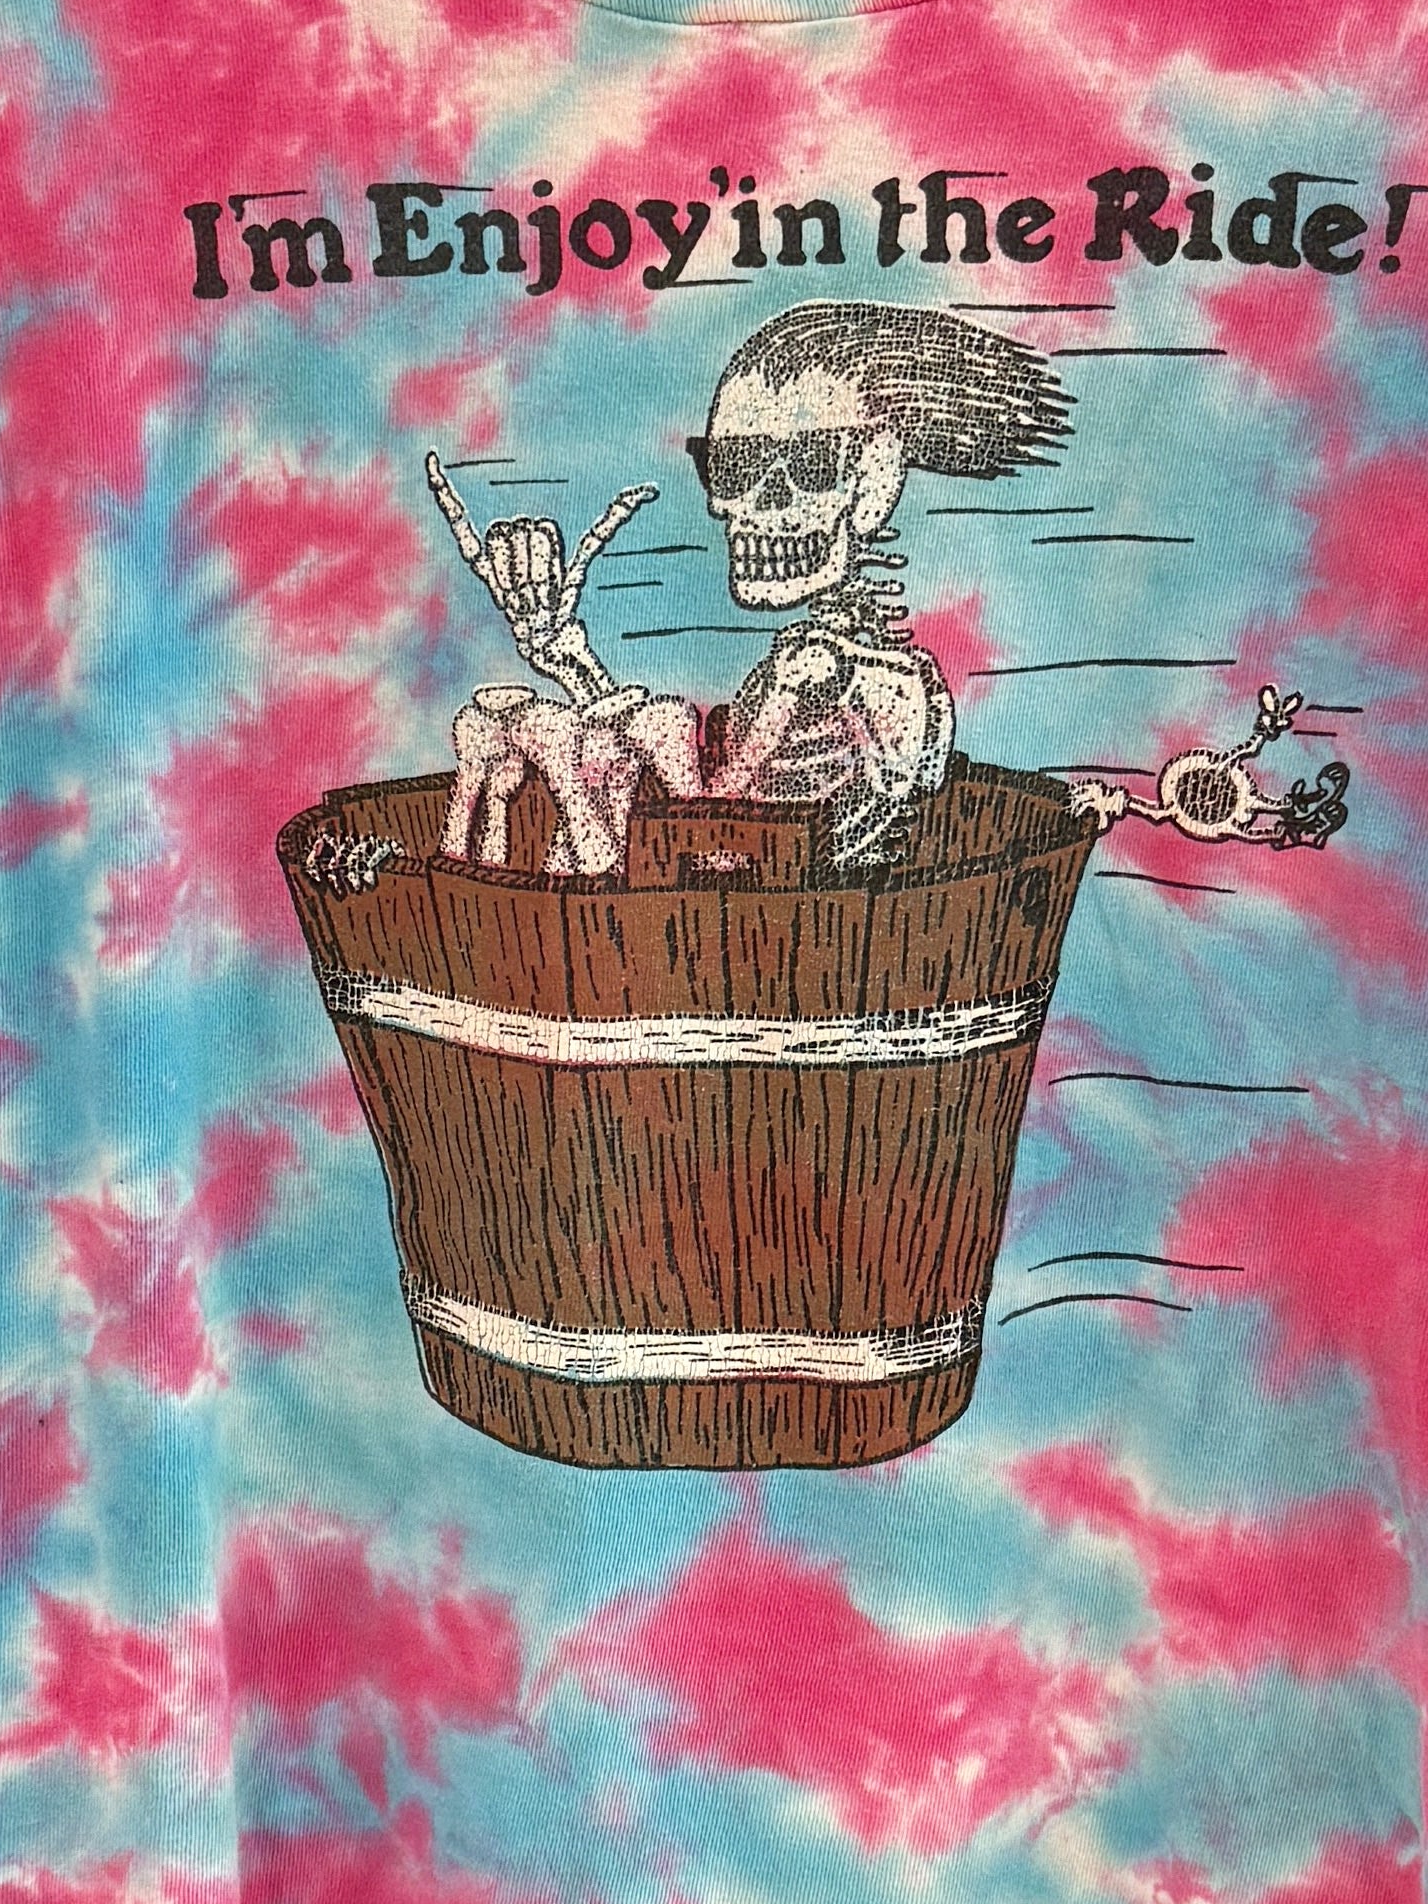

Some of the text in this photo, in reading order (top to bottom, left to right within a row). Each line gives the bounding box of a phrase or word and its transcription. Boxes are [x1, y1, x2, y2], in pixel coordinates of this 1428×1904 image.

[183, 162, 1417, 298] I'm Enjoy'in the Ride!
